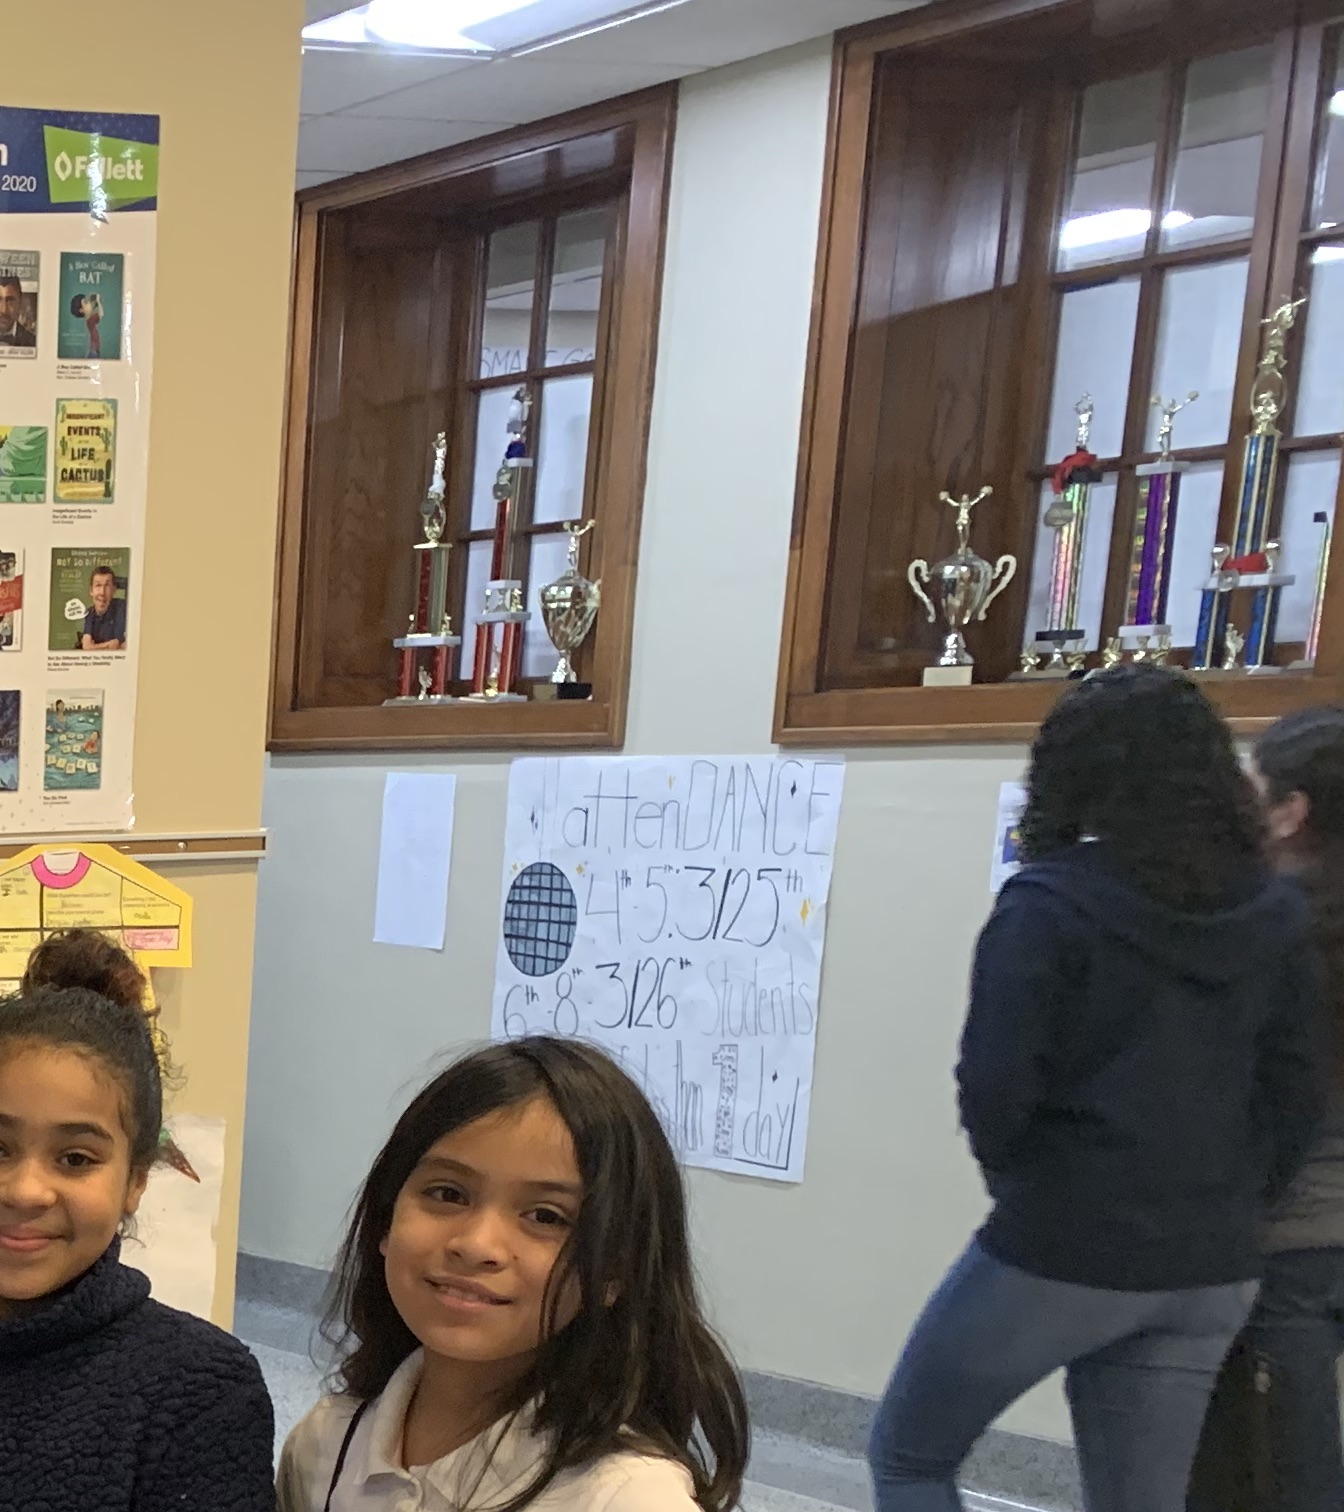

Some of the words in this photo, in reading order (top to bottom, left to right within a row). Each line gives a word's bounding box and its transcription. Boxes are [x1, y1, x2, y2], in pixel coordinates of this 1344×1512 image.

[1, 174, 37, 193] 2020
[78, 270, 102, 285] BAT
[67, 426, 101, 437] EVENTS
[70, 448, 95, 461] LIFE
[60, 467, 104, 483] CACTUS
[700, 953, 814, 1038] Students
